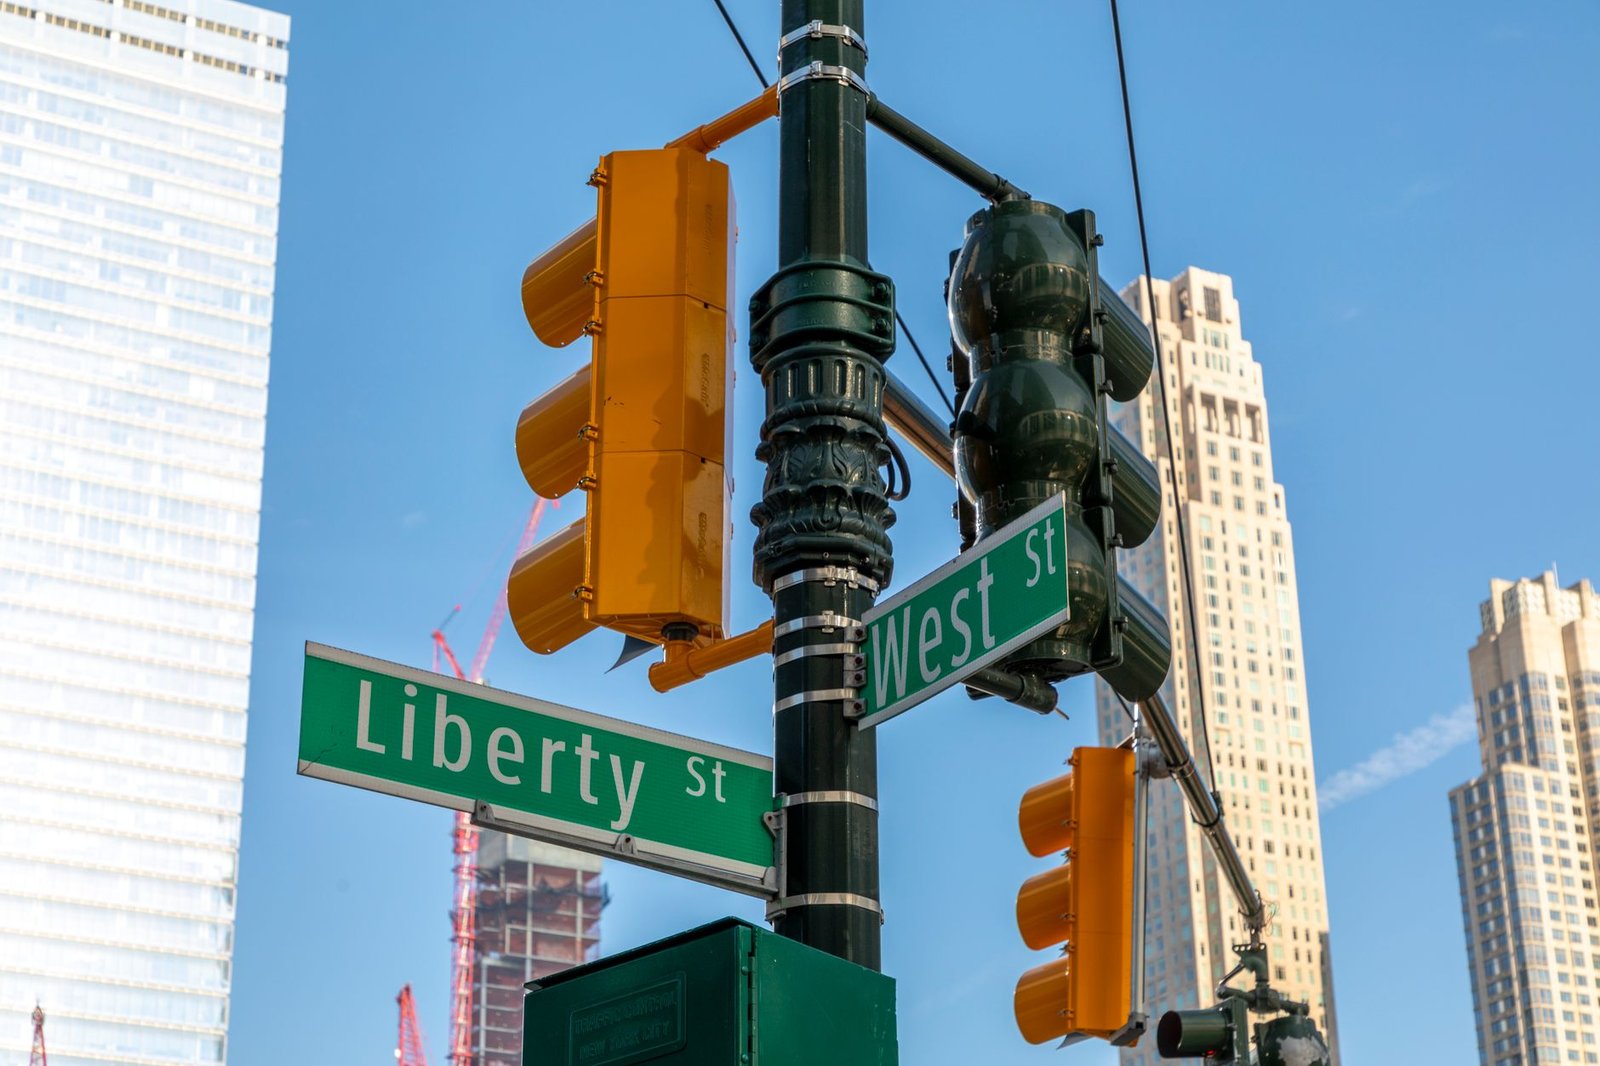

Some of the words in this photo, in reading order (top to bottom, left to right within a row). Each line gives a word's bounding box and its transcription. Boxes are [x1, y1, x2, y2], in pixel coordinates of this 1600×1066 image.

[871, 556, 996, 709] West
[1025, 517, 1056, 588] St
[355, 680, 645, 831] Liberty
[685, 756, 726, 803] St
